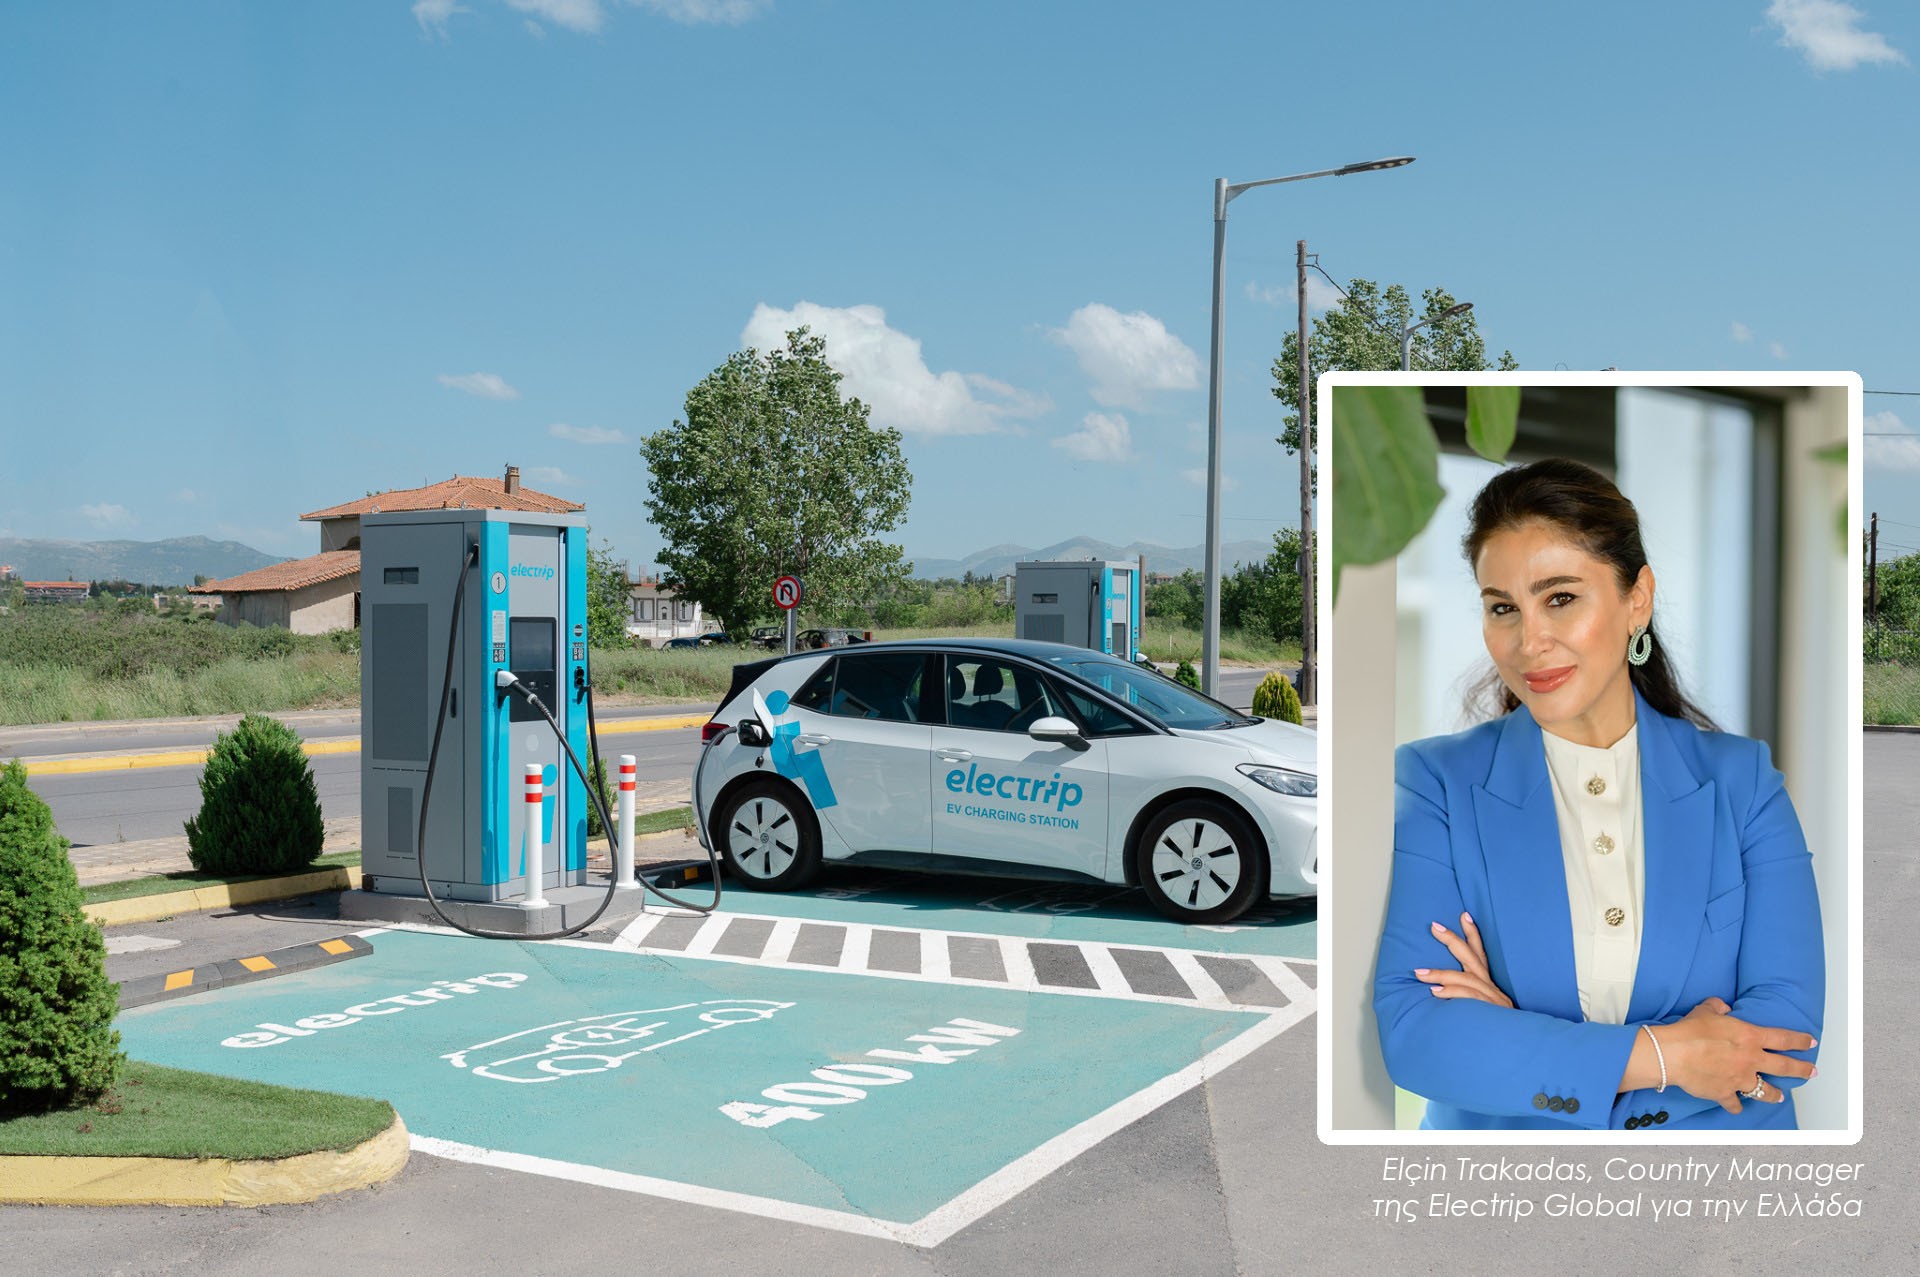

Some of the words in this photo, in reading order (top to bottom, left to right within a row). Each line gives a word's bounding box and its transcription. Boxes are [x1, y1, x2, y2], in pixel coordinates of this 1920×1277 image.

[511, 563, 555, 581] electrip
[946, 763, 1083, 812] electrip
[947, 803, 962, 814] EV
[965, 806, 1026, 823] CHARGING
[1030, 814, 1079, 830] STATION
[220, 972, 529, 1048] electrip
